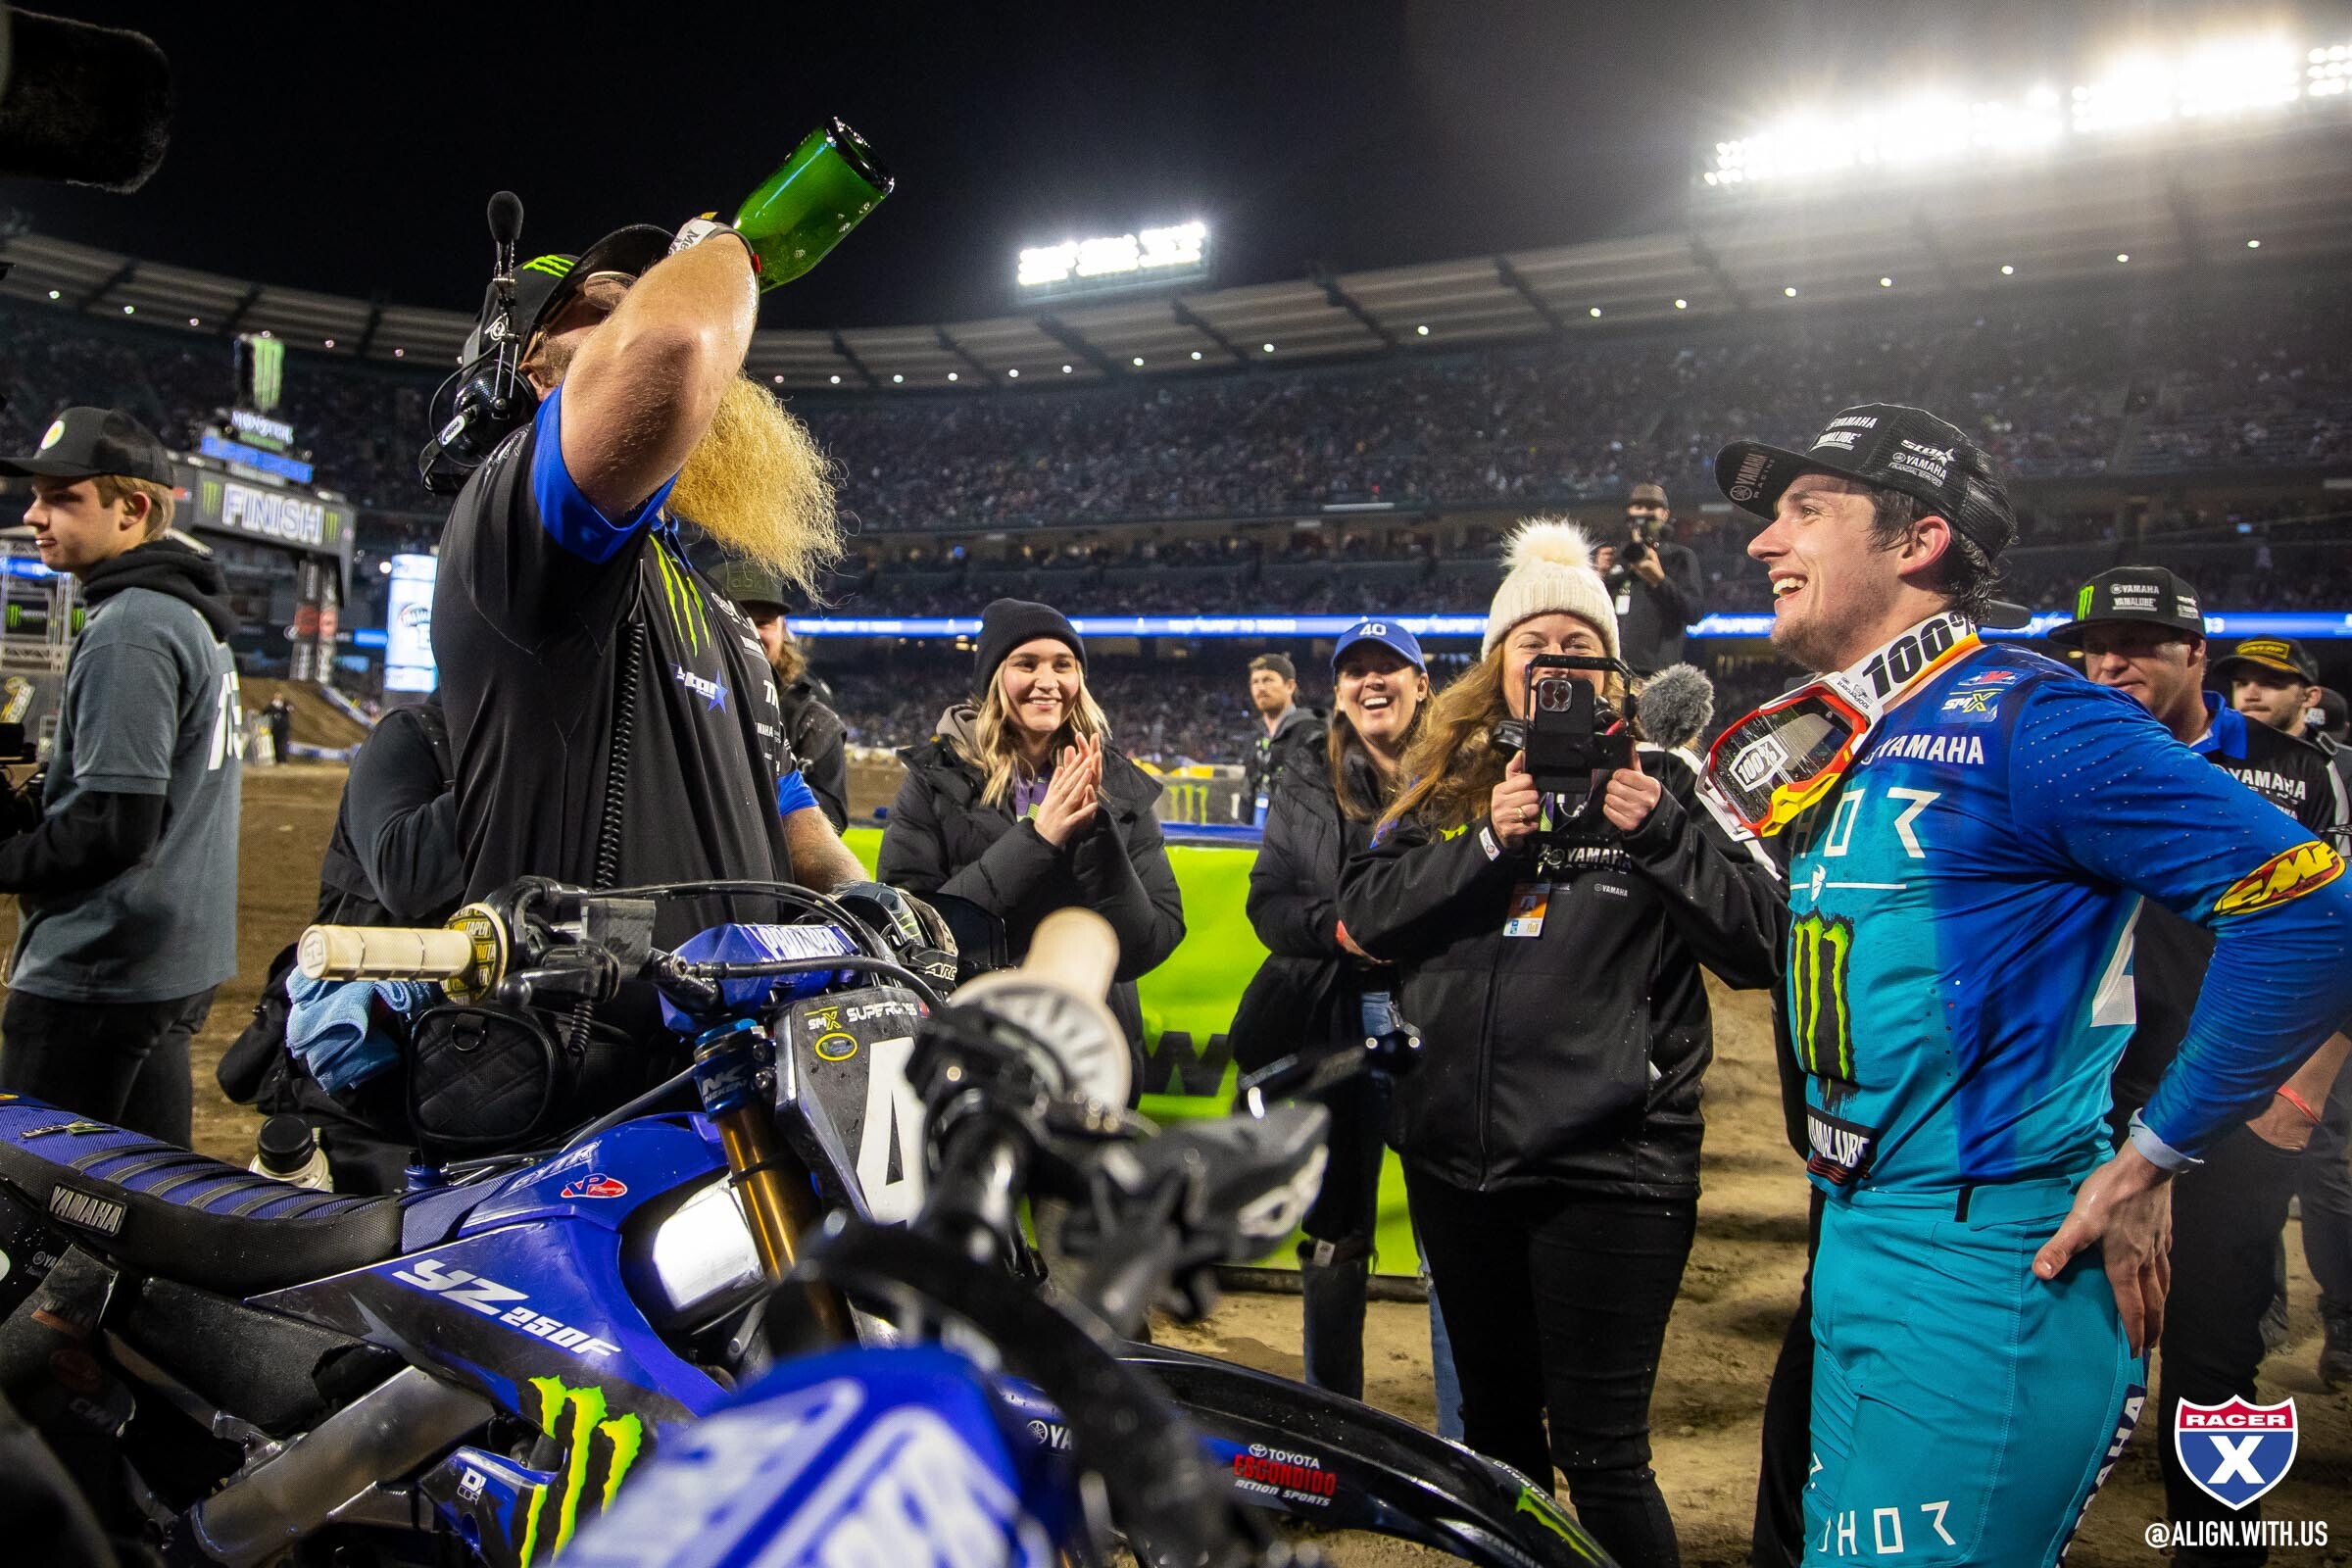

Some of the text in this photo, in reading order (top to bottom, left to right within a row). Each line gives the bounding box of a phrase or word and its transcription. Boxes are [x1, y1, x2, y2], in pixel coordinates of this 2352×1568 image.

[1835, 416, 1879, 429] YAMAHA
[1735, 453, 1768, 486] YAMAHA
[1906, 455, 1947, 480] YAMAHA
[221, 482, 324, 546] FINISH
[2122, 584, 2160, 595] YAMAHA
[1359, 623, 1388, 636] 40
[1940, 691, 1996, 713] SMX
[1738, 743, 1779, 783] 100%
[1878, 734, 1984, 765] YAMAHA
[2229, 767, 2306, 801] YAMAHA
[2221, 840, 2338, 911] FMF
[1602, 884, 1628, 898] YAMAHA
[808, 1010, 843, 1031] SMX
[49, 1185, 123, 1233] YAMAHA
[391, 1258, 622, 1357] YZ 250F
[1268, 1447, 1321, 1469] TOYOTA
[1233, 1454, 1338, 1496] ESCONDIDO
[1234, 1479, 1331, 1507] ACTION SPORTS
